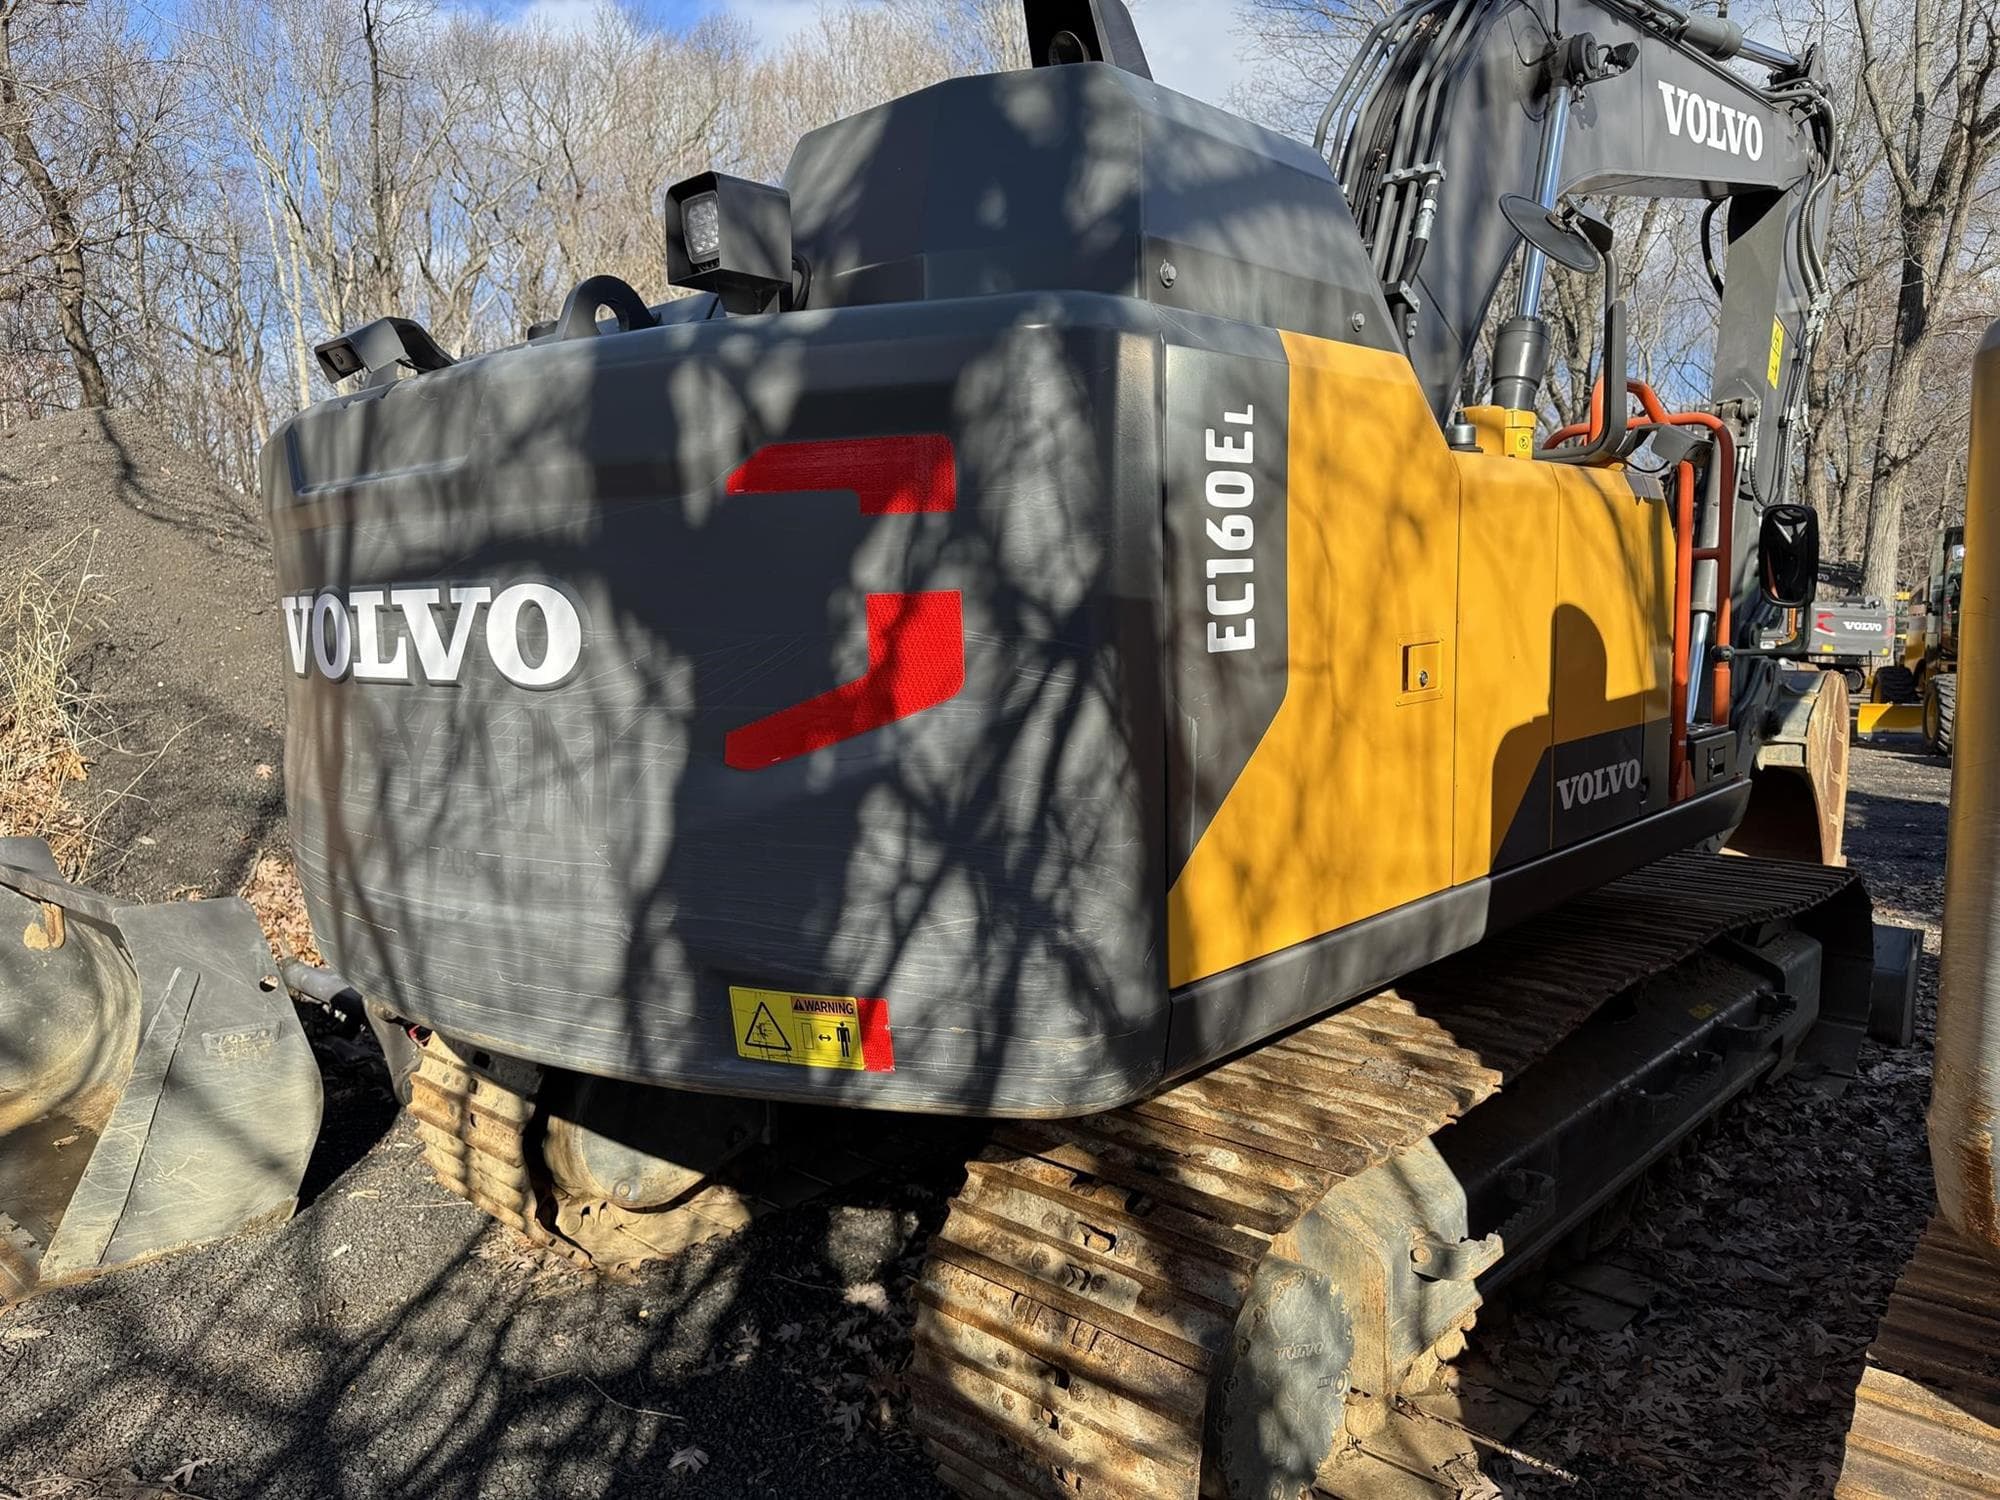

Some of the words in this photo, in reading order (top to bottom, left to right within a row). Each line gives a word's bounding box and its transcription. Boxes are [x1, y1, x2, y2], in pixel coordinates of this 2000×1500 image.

[1658, 80, 1763, 162] VOLVO
[1205, 404, 1256, 653] EC160EL
[282, 583, 582, 686] VOLVO
[1843, 621, 1882, 632] VOLVO
[1556, 759, 1641, 810] VOLVO
[804, 999, 854, 1015] WARNING
